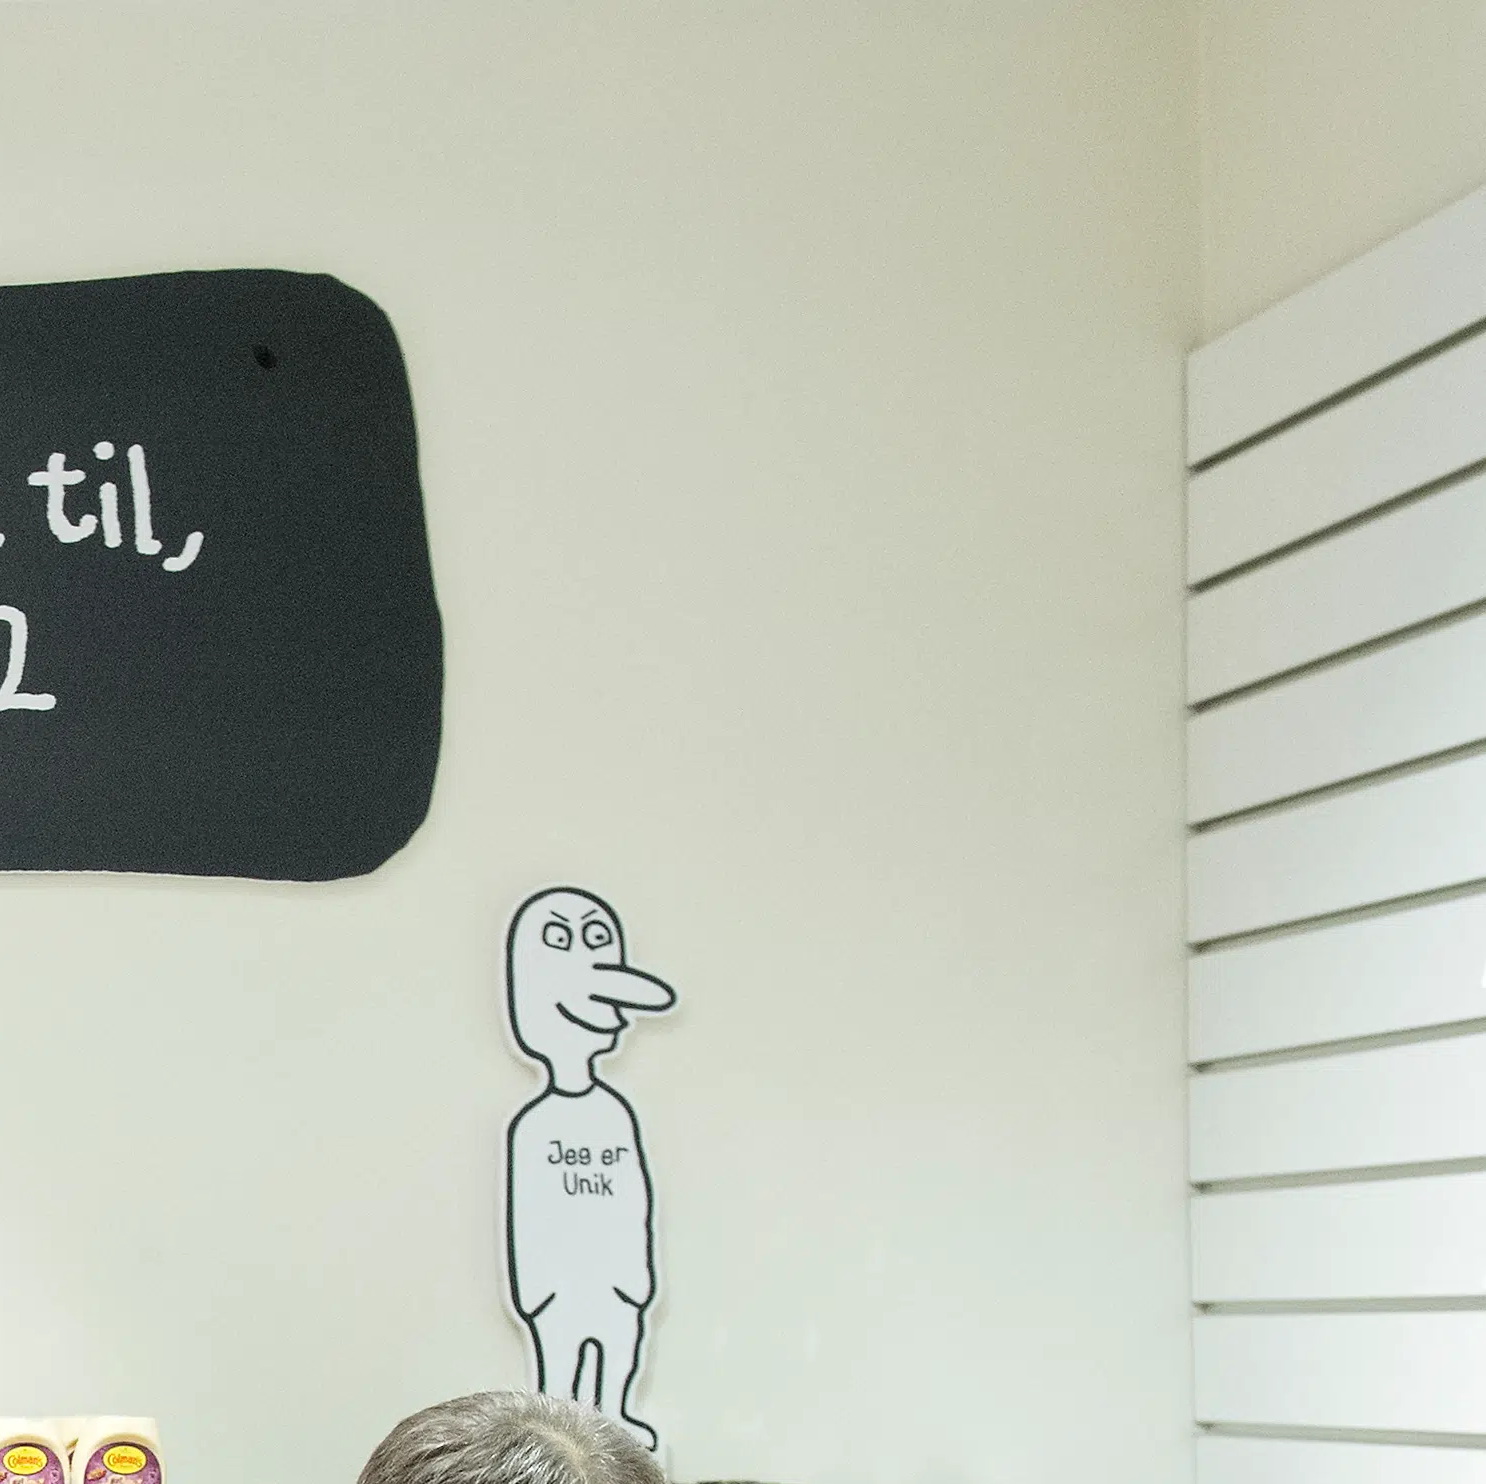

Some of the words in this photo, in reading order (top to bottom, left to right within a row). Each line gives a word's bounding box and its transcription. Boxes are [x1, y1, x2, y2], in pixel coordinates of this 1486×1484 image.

[28, 440, 204, 572] til,
[547, 1140, 592, 1165] Jeg
[601, 1146, 629, 1166] er
[563, 1171, 614, 1196] Unik
[7, 1456, 45, 1469] Colman's
